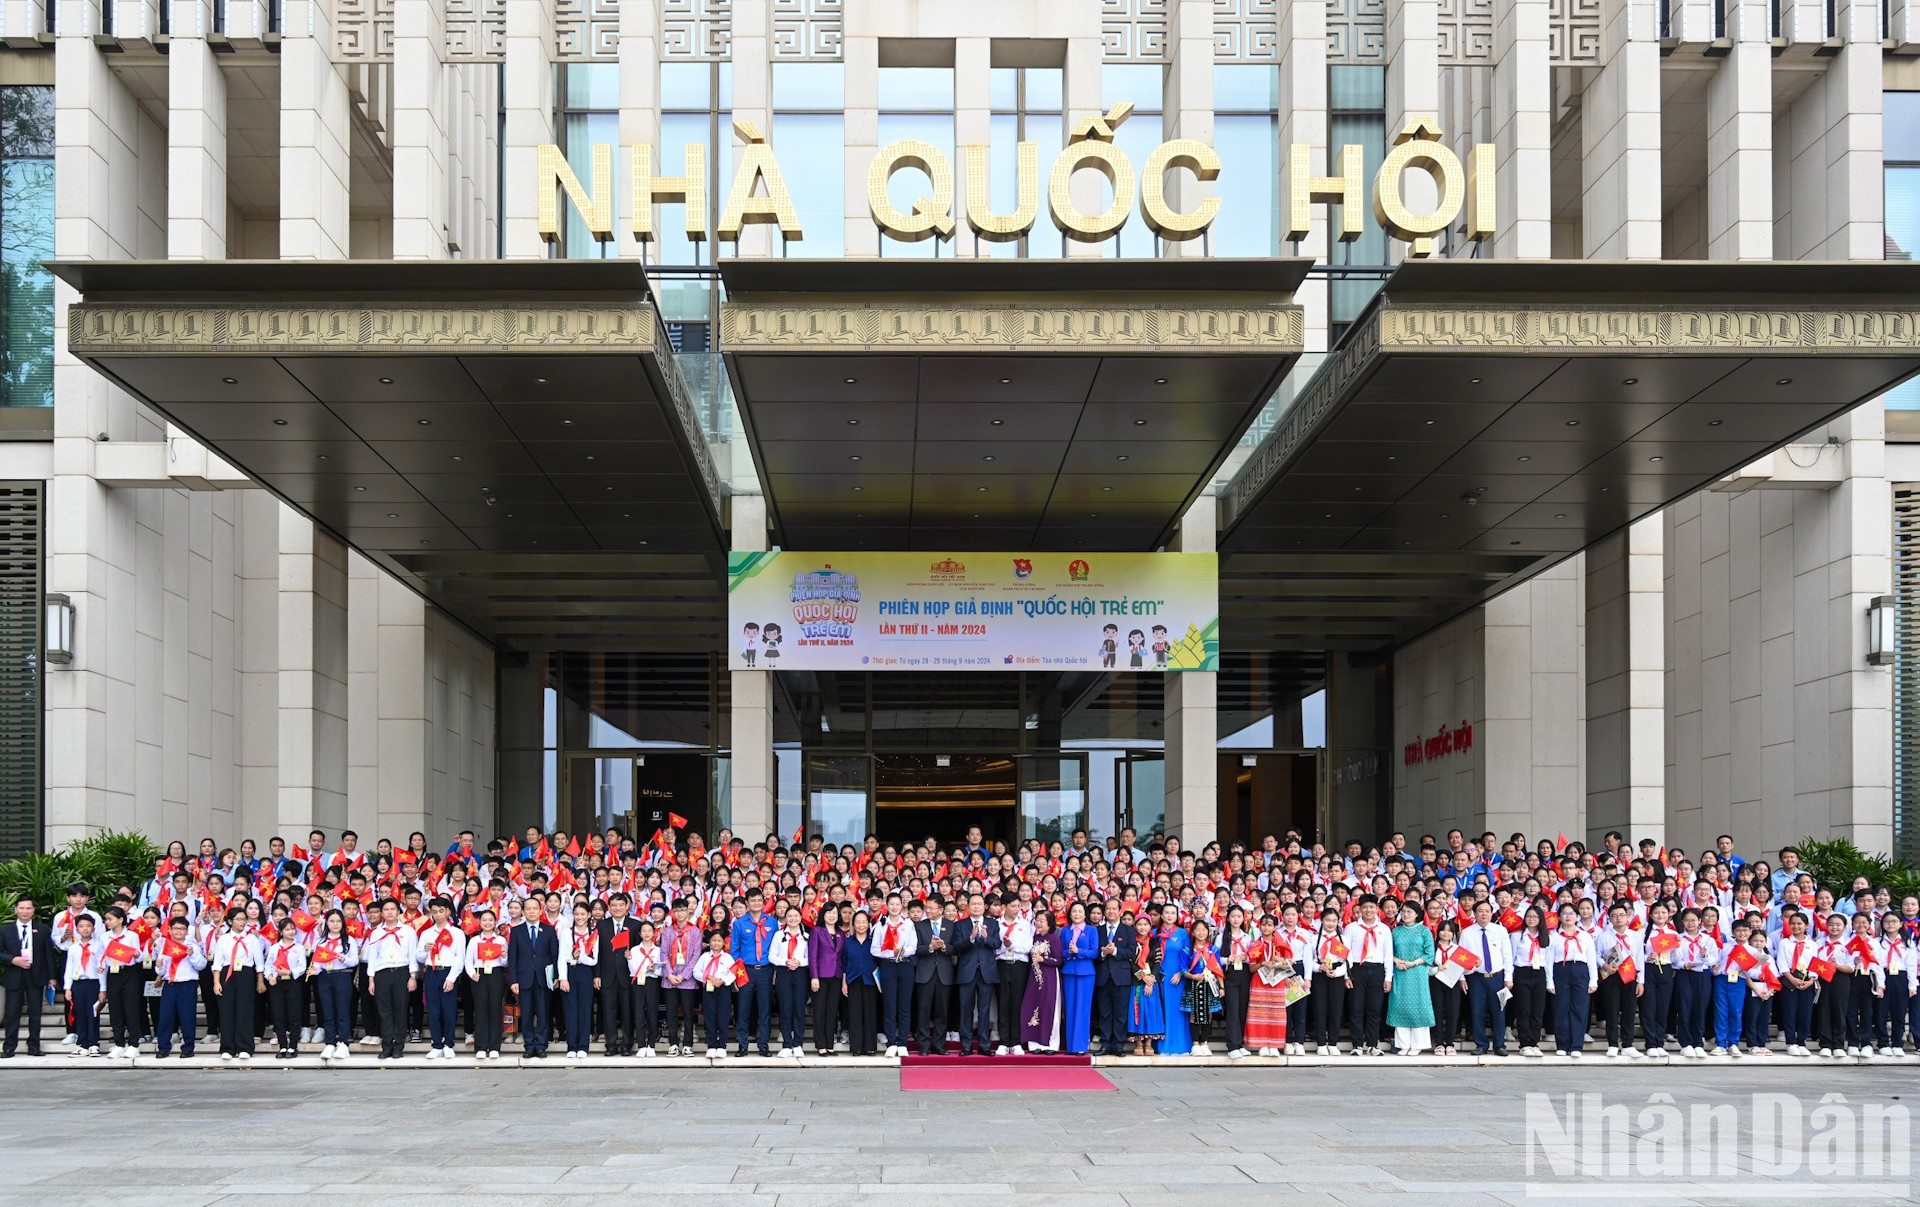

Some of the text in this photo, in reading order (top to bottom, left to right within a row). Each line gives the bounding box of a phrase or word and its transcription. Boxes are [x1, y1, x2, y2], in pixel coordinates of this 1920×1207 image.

[538, 102, 1496, 258] NHÀ QUỐC HỘI
[793, 599, 858, 624] QUỐC HỘI
[879, 598, 919, 615] PHIÊN
[924, 601, 950, 618] HỌP
[954, 597, 977, 615] GIẢ
[981, 601, 1012, 618] ĐỊNH
[1016, 594, 1067, 618] "QUỐC
[1070, 596, 1095, 618] HỘI
[1100, 596, 1128, 616] TRẺ
[800, 621, 828, 638] TRẺ
[879, 621, 896, 635] LẦN
[899, 622, 919, 635] THỨ
[921, 624, 928, 634] II
[937, 623, 958, 635] NĂM
[961, 624, 986, 635] 2024
